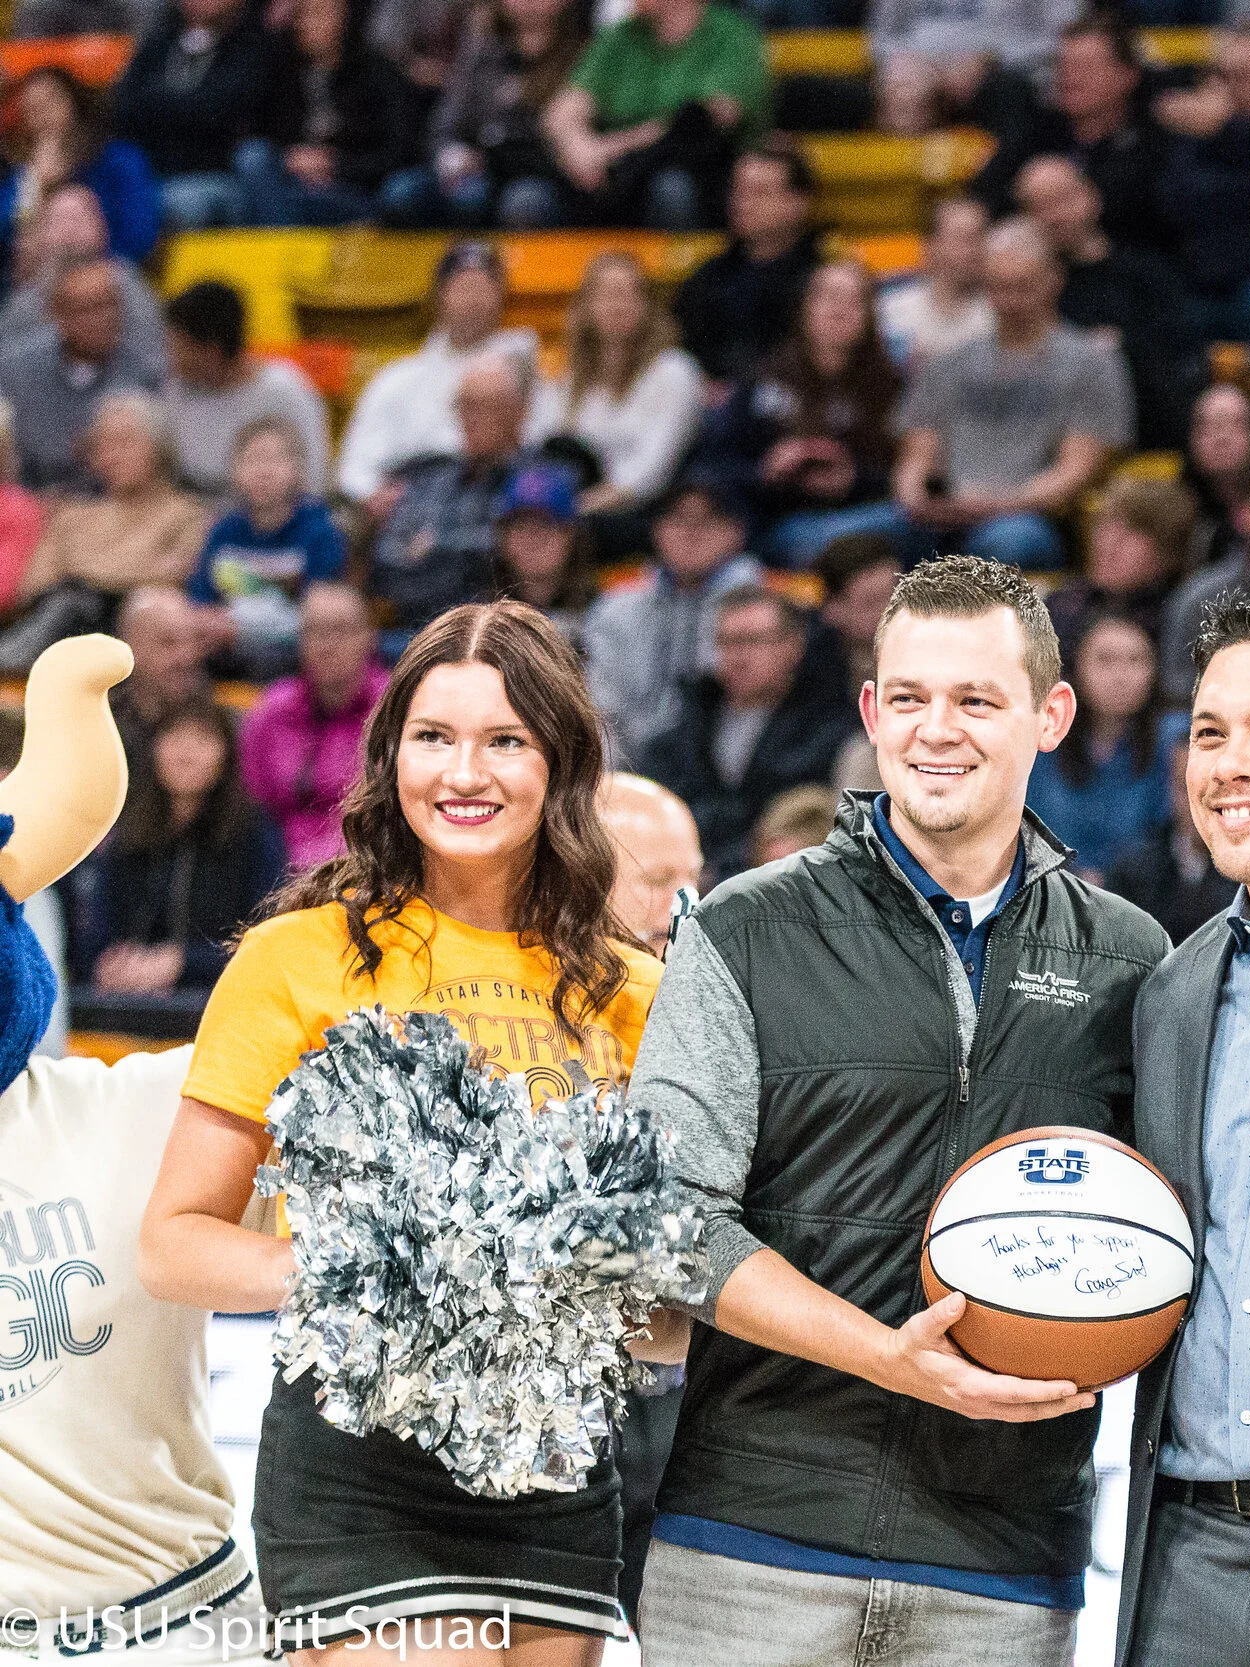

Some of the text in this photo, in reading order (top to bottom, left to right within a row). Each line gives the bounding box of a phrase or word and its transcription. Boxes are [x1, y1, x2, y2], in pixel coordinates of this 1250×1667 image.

[436, 982, 479, 1003] UTAH
[1008, 980, 1091, 1003] AMERICA FIRST
[1024, 992, 1075, 1008] CREDIT UNION
[1018, 1158, 1091, 1174] STATE
[981, 1234, 1031, 1258] Thanks
[1036, 1225, 1056, 1248] for
